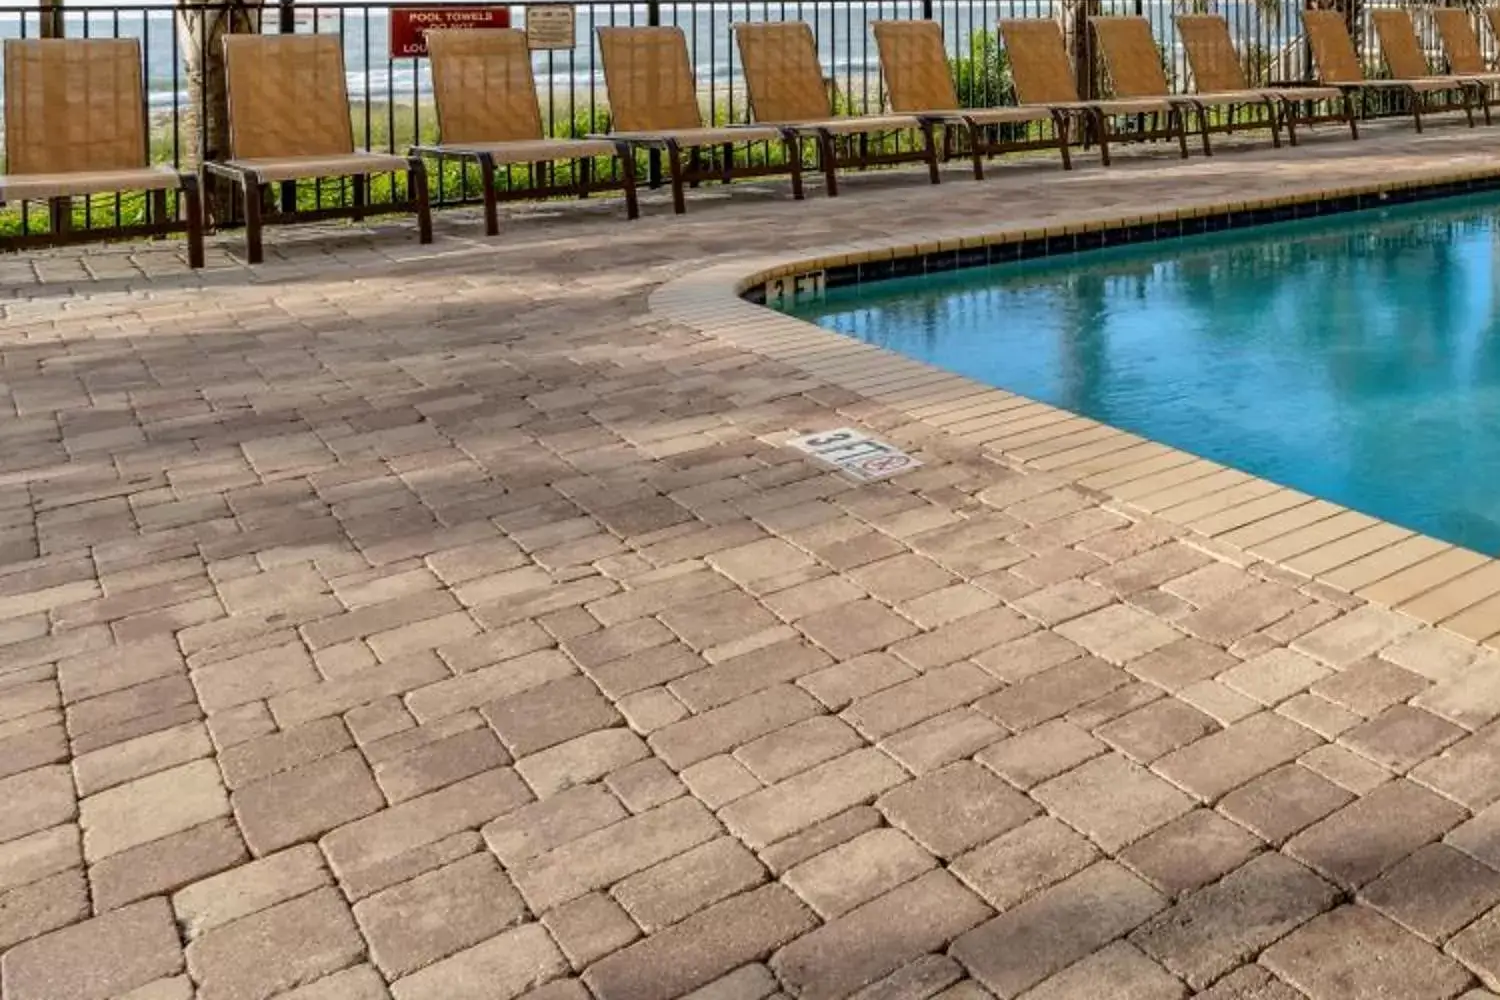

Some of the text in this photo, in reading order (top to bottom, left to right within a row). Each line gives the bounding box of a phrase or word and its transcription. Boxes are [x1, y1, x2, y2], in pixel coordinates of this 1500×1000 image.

[409, 11, 493, 22] POOL TOWELS
[403, 44, 428, 53] LOU
